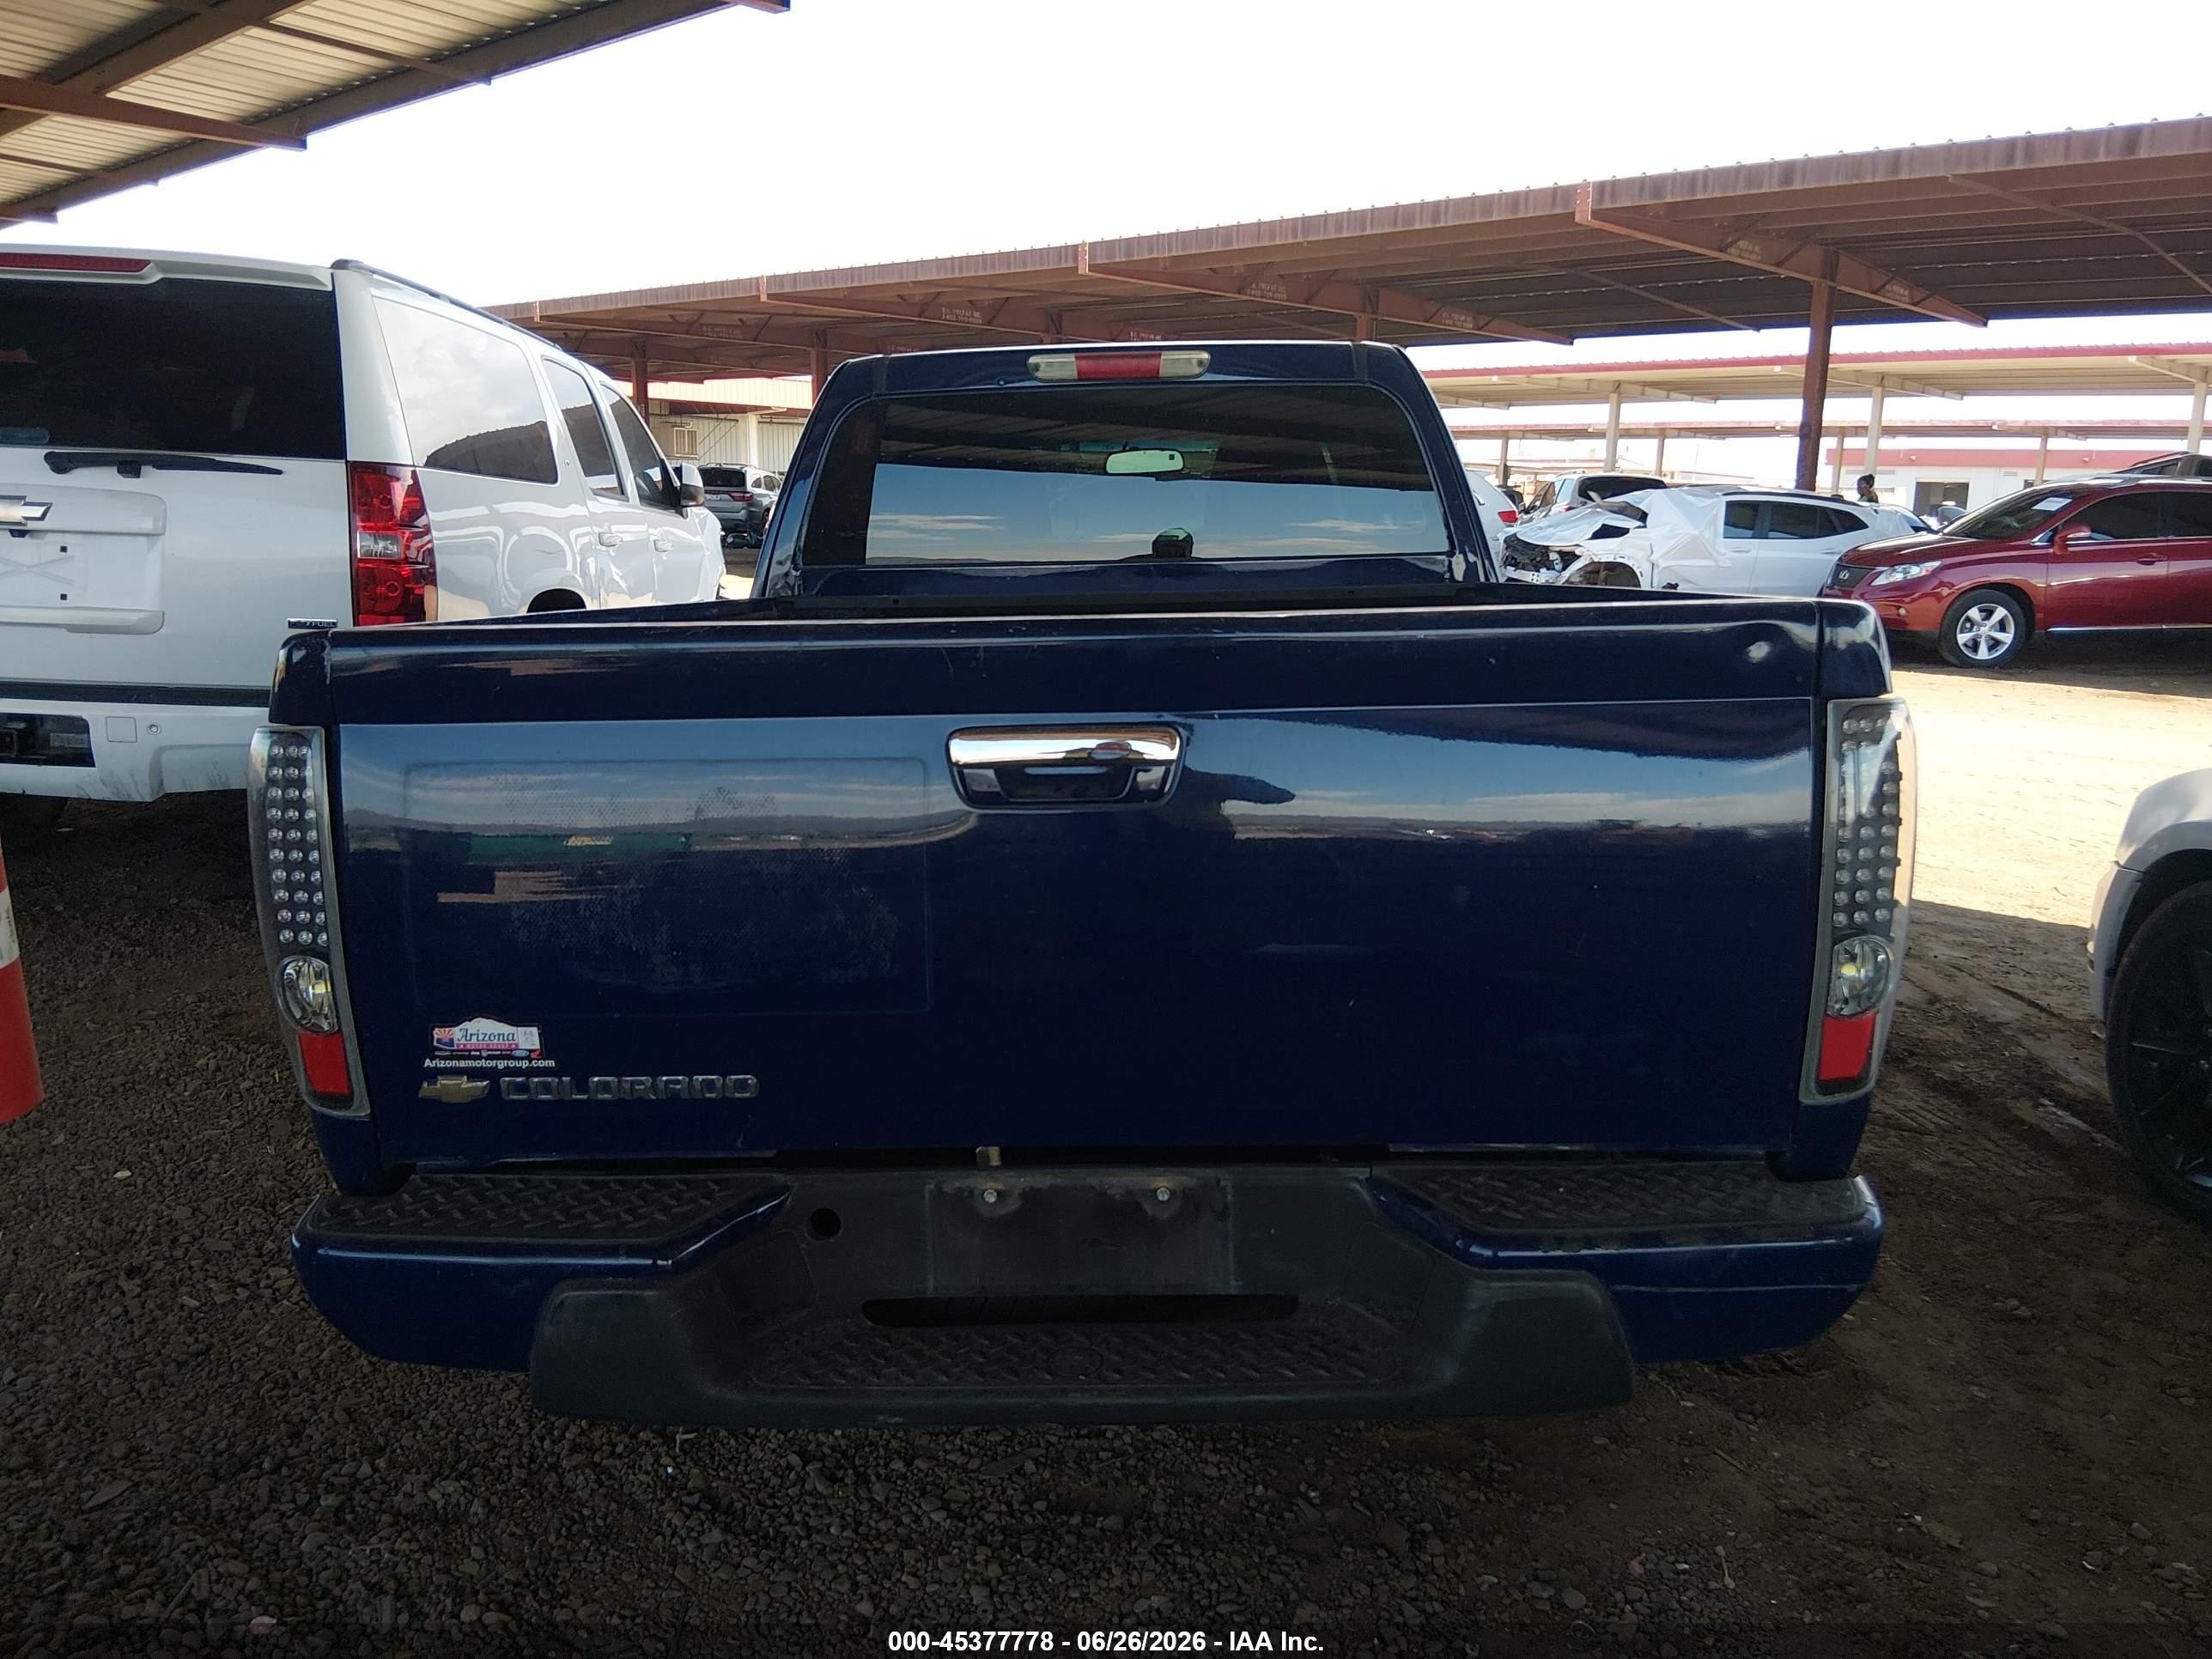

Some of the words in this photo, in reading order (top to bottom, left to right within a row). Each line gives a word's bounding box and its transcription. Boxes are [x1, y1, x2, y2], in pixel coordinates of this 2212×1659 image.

[457, 1028, 517, 1042] Arizona
[424, 1058, 556, 1070] Arizonamotorgroup.com
[500, 1075, 760, 1100] COLORADO
